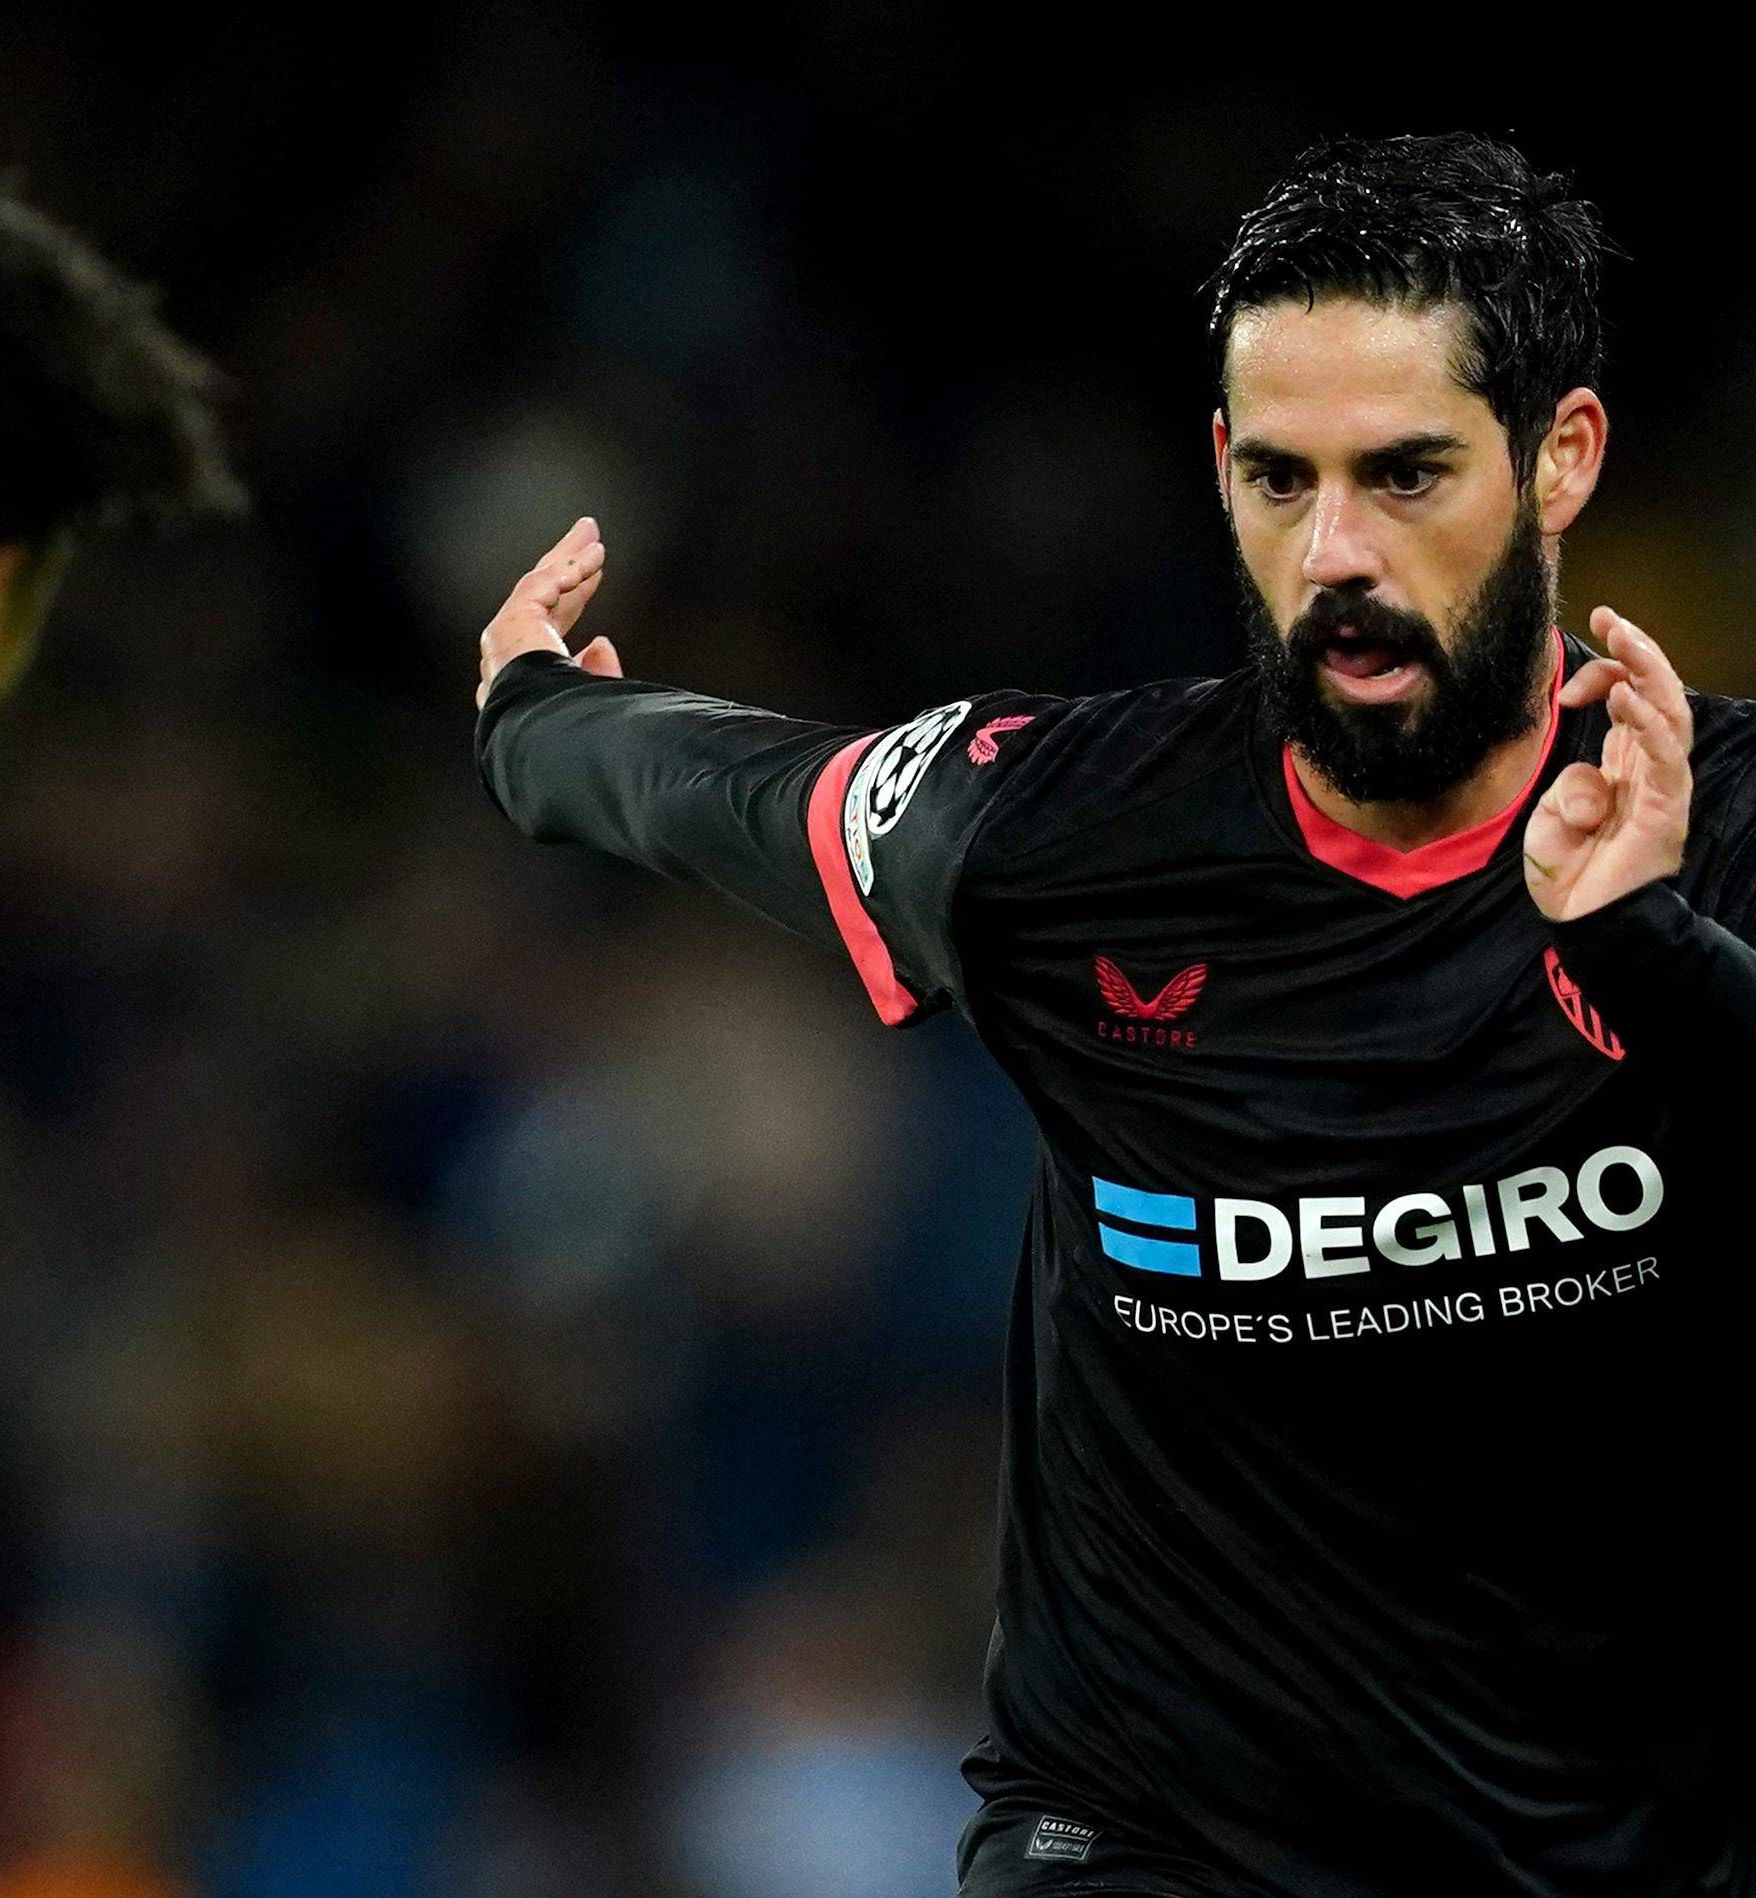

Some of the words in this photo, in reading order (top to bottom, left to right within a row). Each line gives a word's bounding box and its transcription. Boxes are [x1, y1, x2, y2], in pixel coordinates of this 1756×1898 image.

[1098, 1021, 1197, 1047] CASTORE
[1214, 1146, 1664, 1281] DEGIRO
[1306, 1292, 1485, 1341] LEADING
[1498, 1256, 1660, 1317] BROKER
